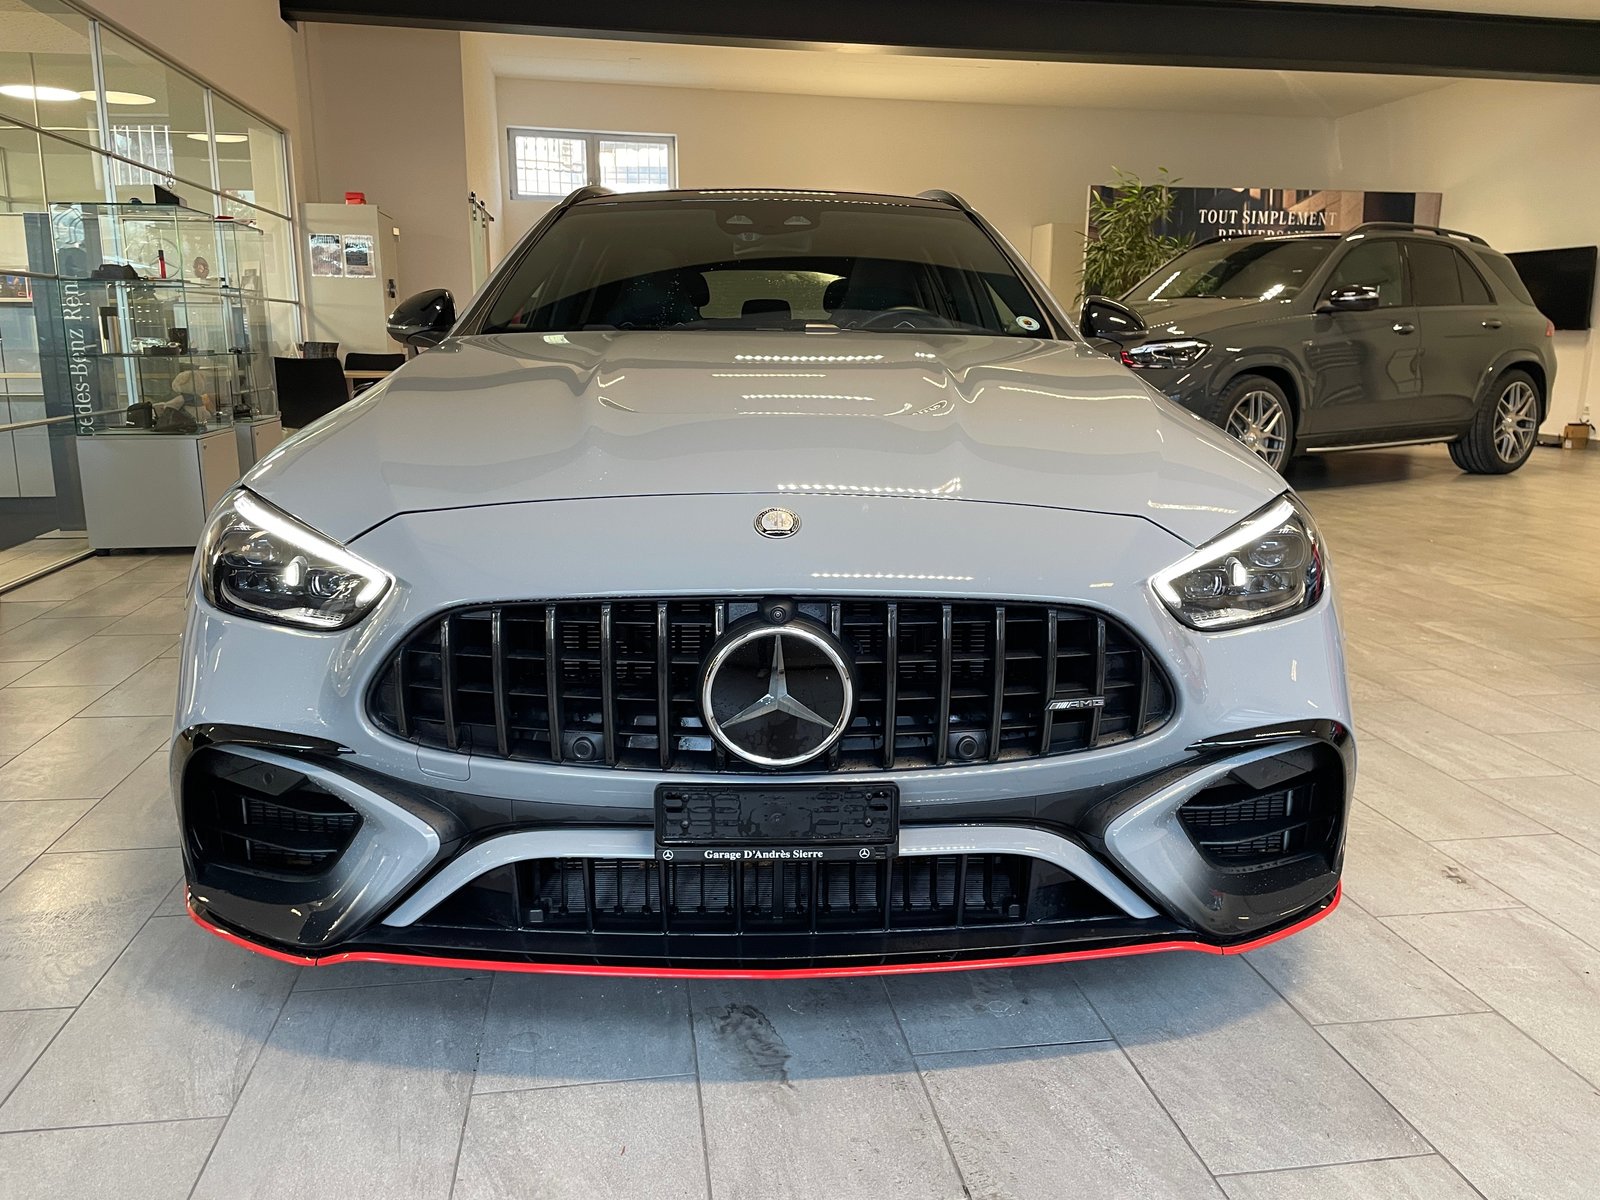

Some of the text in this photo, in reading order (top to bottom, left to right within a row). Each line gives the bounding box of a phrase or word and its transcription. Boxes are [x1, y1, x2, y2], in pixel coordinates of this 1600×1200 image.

[1199, 209, 1337, 226] TOUT SIMPLEMENT
[69, 328, 95, 436] cedes-Benz
[1065, 699, 1105, 710] AMG
[704, 849, 823, 860] Garage D'Andrès Sierre
